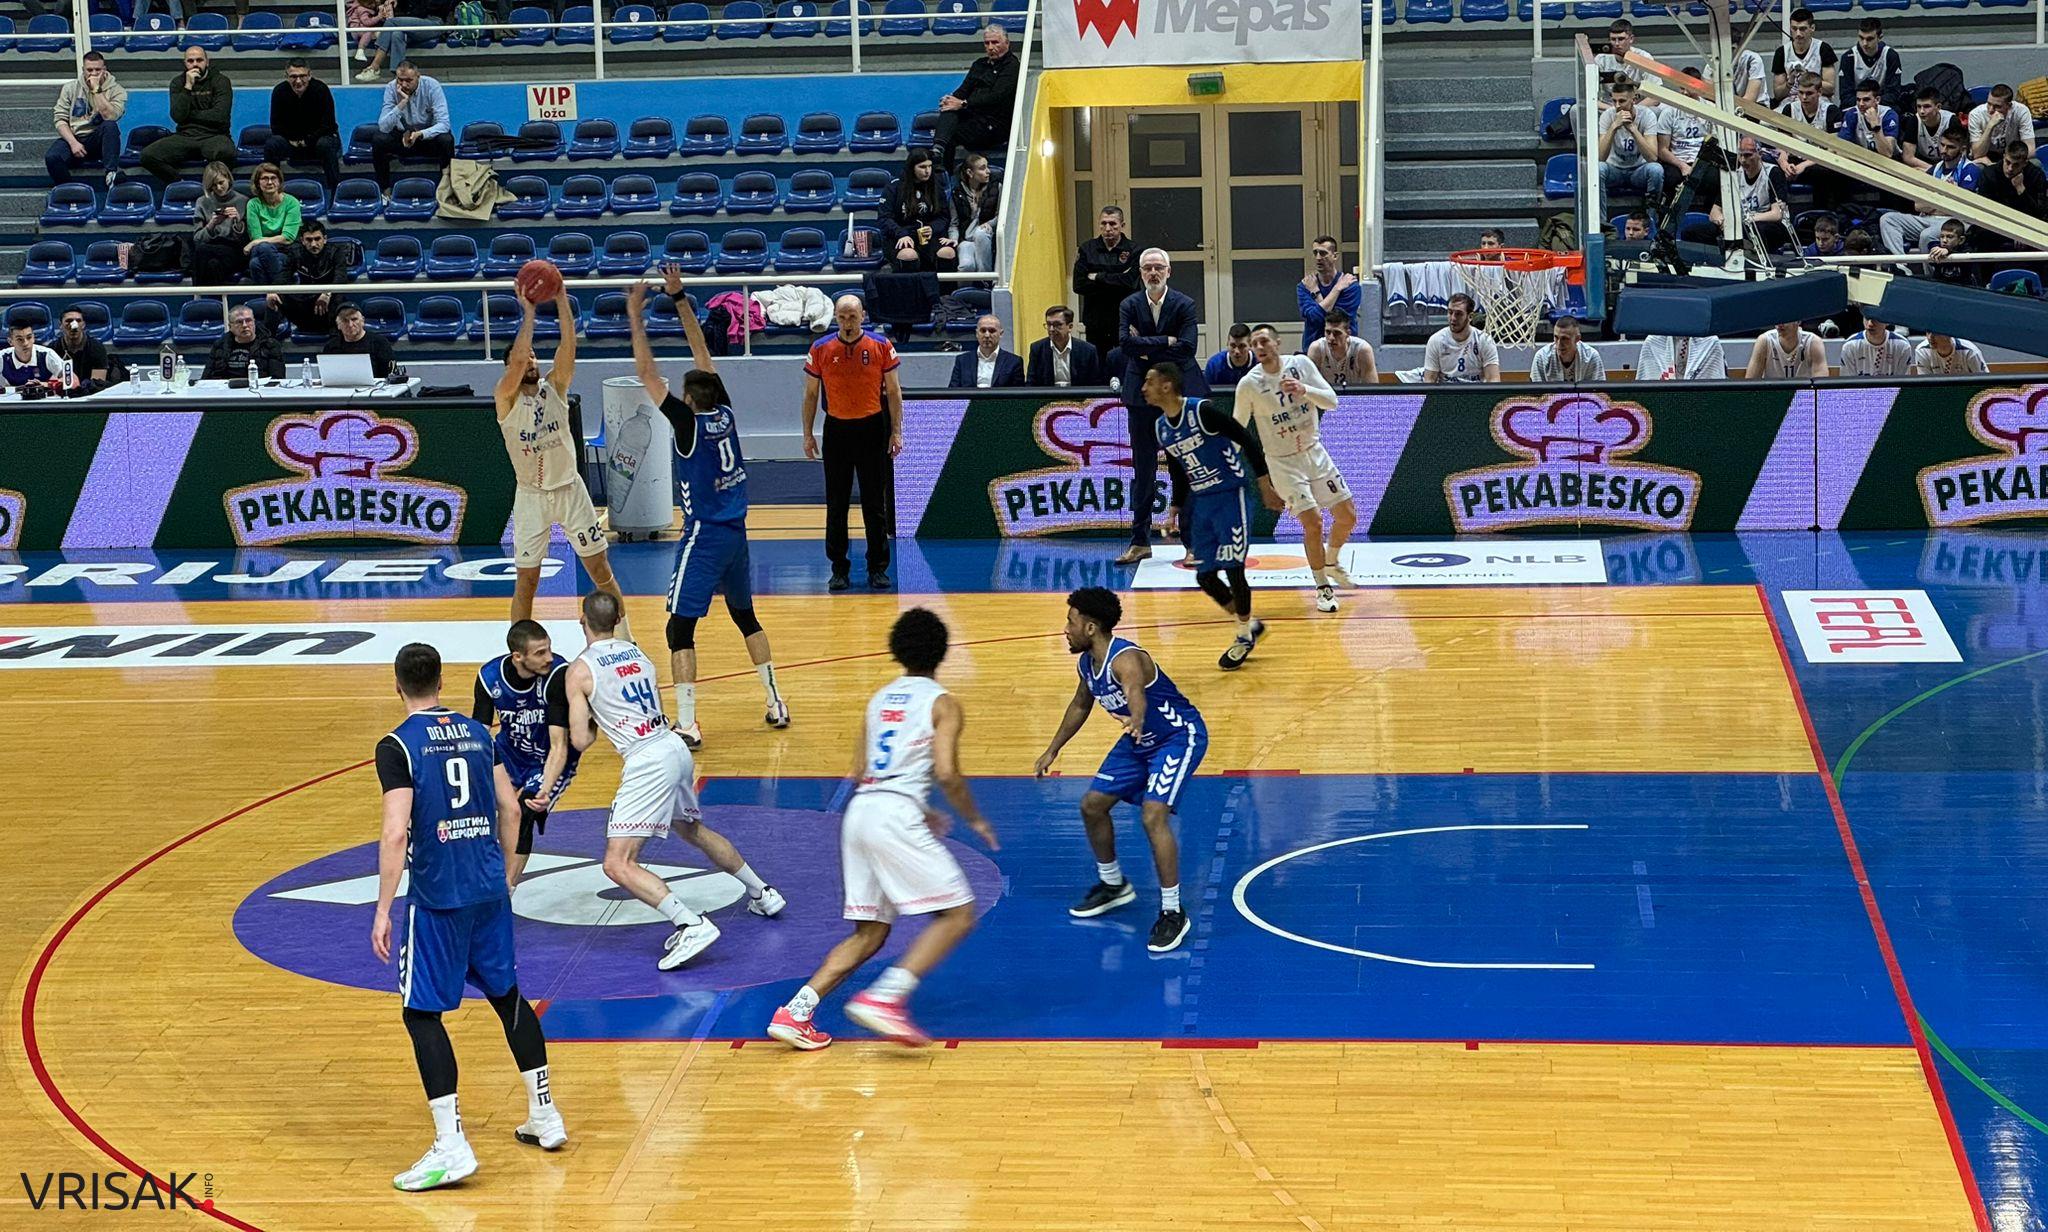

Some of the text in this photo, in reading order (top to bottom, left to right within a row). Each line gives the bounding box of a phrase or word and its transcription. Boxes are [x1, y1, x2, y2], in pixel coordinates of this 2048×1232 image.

[1153, 0, 1332, 46] Mepas
[532, 86, 571, 106] VIP
[539, 107, 566, 119] loža
[1623, 138, 1634, 152] 18
[1457, 357, 1466, 373] 8
[718, 437, 735, 473] 0
[239, 487, 451, 533] PEKABESKO
[1004, 477, 1168, 522] PEKABS
[1460, 472, 1685, 520] PEKABESKO
[1486, 554, 1588, 564] NLB
[621, 678, 657, 714] 44
[510, 723, 531, 740] 24
[874, 729, 898, 770] 5
[446, 757, 471, 809] 9
